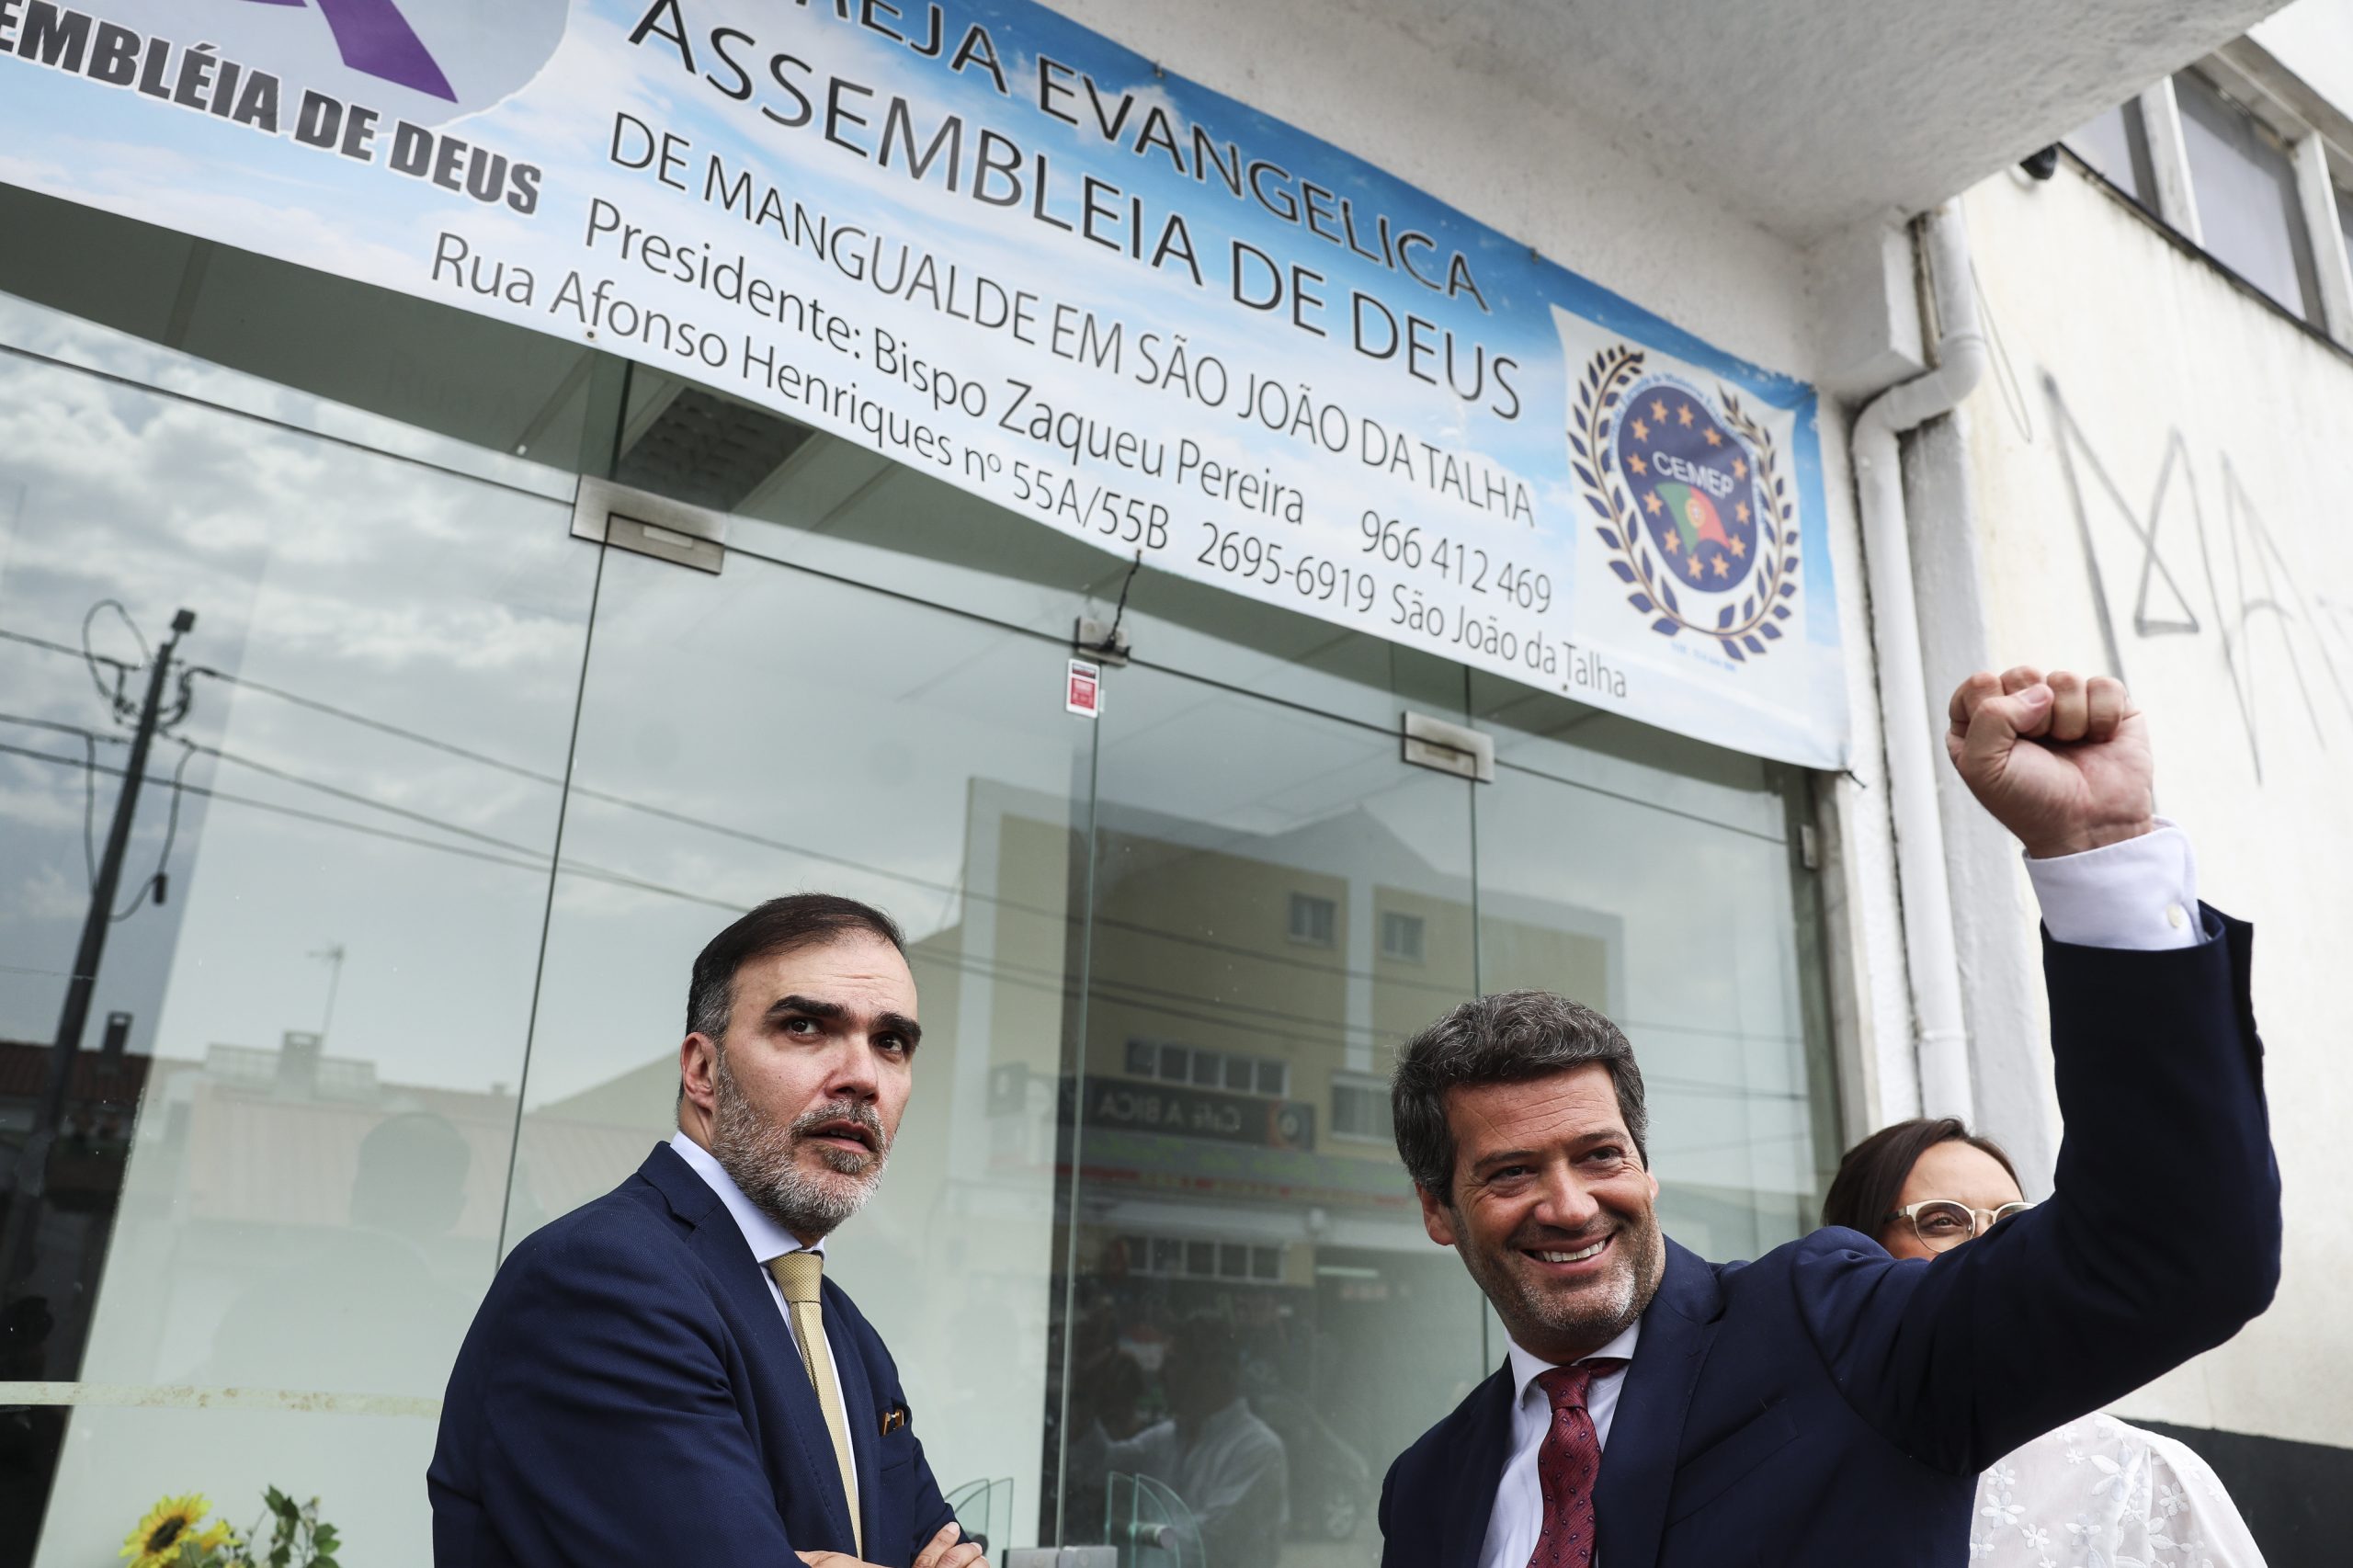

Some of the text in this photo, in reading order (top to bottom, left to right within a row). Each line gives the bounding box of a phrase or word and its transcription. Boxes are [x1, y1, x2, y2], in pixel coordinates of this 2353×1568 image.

[295, 89, 380, 162] DE
[389, 119, 543, 216] DEUS
[610, 111, 691, 192] DE
[704, 153, 1040, 347] MANGUALDE
[1051, 303, 1123, 376] EM
[1134, 334, 1229, 409] SÃO
[1236, 372, 1350, 454] JOÃO
[628, 0, 1521, 422] ASSEMBLEIA DE DEUS
[792, 0, 1489, 312] EJA EVANGELICA
[431, 231, 536, 307] Rua
[549, 270, 729, 369] Afonso
[742, 335, 954, 468] Henriques
[1013, 460, 1170, 551] 55A/55B
[1197, 522, 1376, 613] 2695-6919
[1391, 583, 1446, 637] São
[1452, 606, 1518, 662] João
[1525, 631, 1557, 674] da
[1562, 641, 1626, 699] Talha
[585, 197, 1305, 526] Presidente: Bispo Zaqueu Pereira
[1652, 450, 1734, 499] CEMEP
[1361, 509, 1552, 615] 966 412 469
